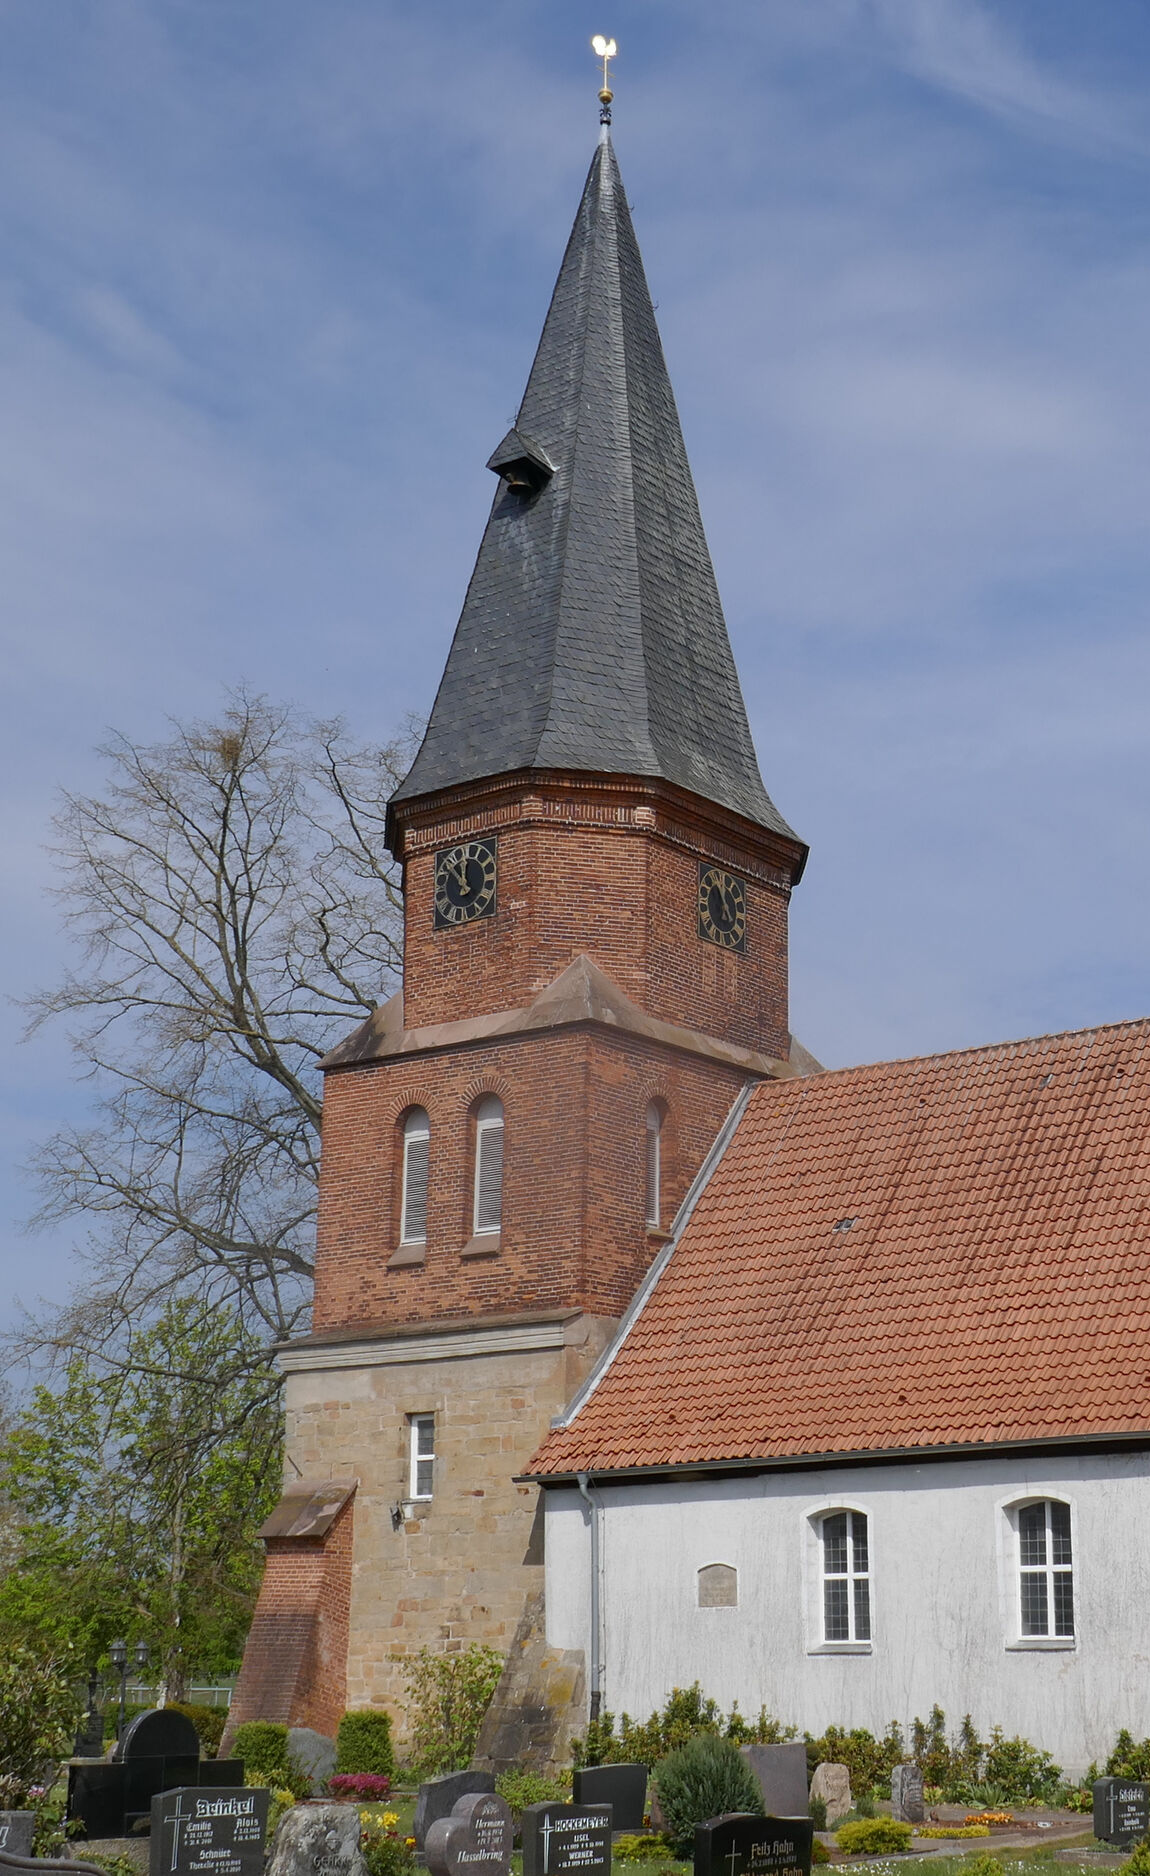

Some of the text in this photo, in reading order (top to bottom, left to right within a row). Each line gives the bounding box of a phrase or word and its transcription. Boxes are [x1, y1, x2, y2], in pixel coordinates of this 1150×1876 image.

[555, 1816, 609, 1832] HOCKEMEYER
[568, 1850, 594, 1860] WERNER
[773, 1839, 794, 1856] Hahn
[457, 1849, 504, 1863] Hasselbring
